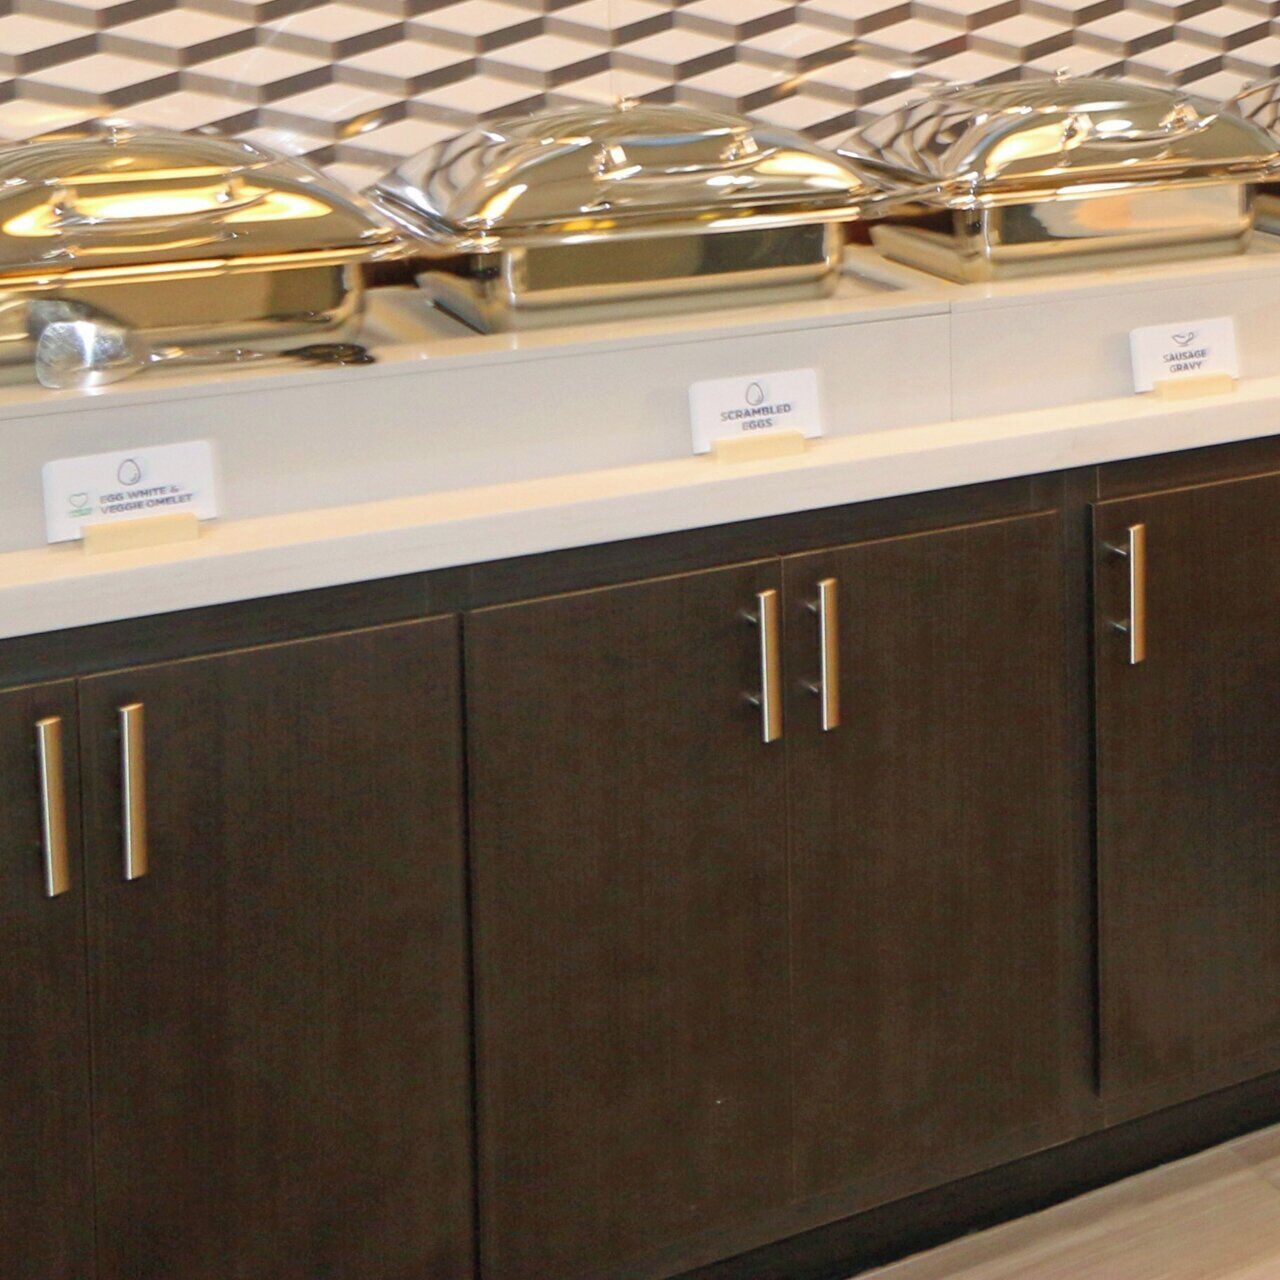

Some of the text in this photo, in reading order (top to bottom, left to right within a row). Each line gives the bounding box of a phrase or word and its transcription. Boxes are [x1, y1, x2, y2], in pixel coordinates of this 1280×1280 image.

[1162, 348, 1208, 363] SAUSAGE
[1169, 360, 1203, 374] GRAVY
[720, 403, 792, 422] SCRAMBLED
[741, 418, 774, 431] EGGS
[100, 491, 124, 504] EGG
[127, 486, 168, 499] WHITE
[101, 501, 145, 515] VEGGIE
[146, 494, 194, 508] OMELET
